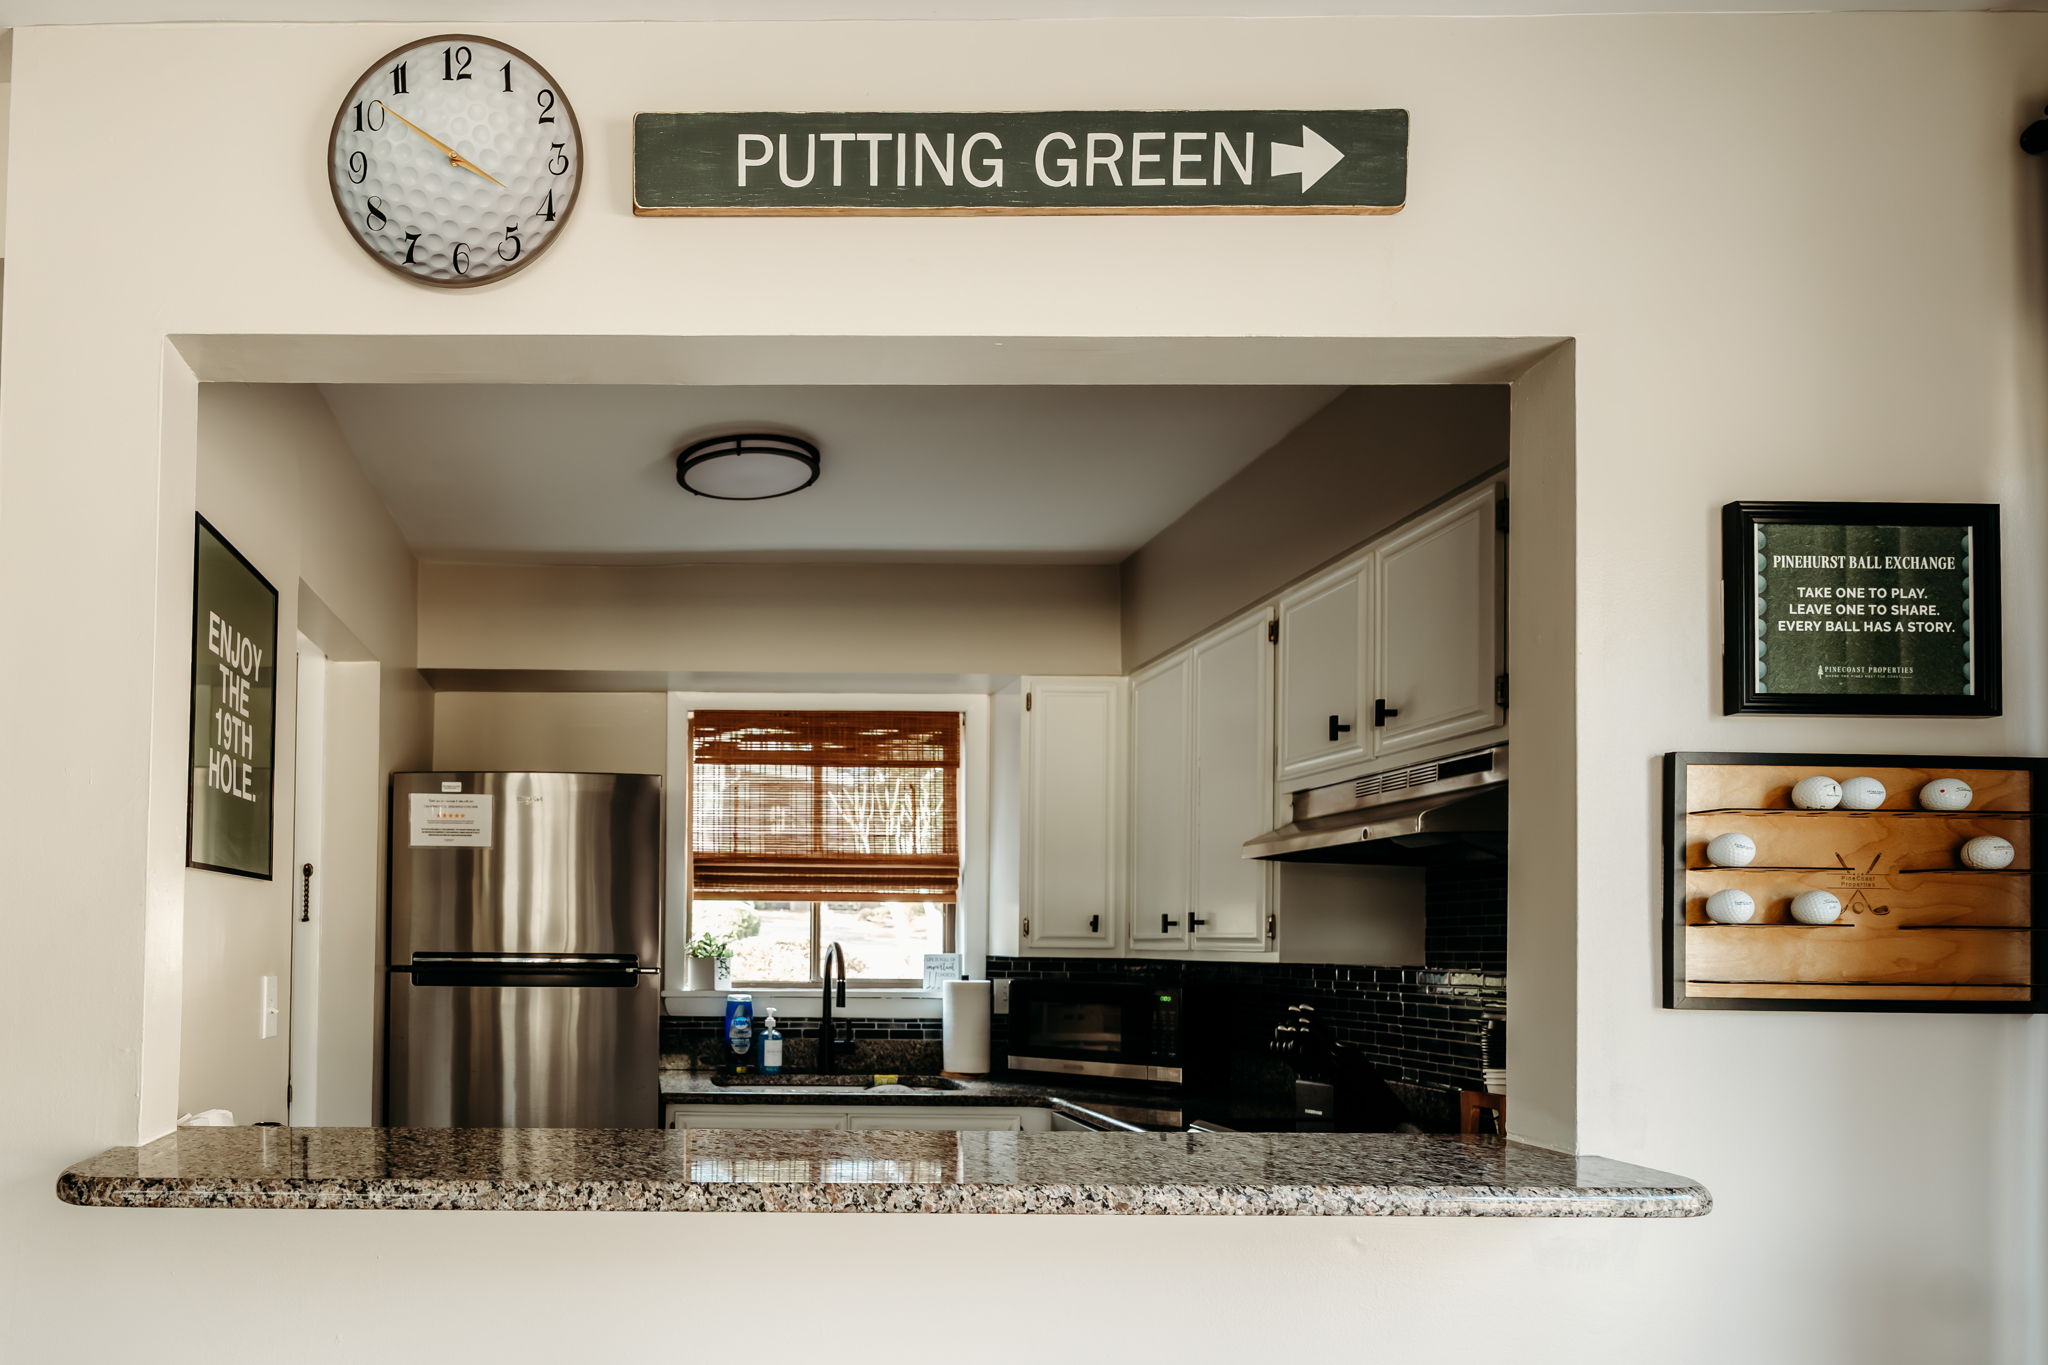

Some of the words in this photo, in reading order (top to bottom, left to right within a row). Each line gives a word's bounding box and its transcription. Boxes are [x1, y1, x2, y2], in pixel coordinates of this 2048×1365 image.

[389, 60, 409, 96] 11
[442, 46, 472, 81] 12
[499, 60, 514, 92] 1
[353, 99, 385, 132] 10
[537, 89, 555, 124] 2
[348, 151, 367, 184] 9
[548, 142, 569, 175] 3
[737, 132, 1004, 188] PUTTING
[1035, 131, 1255, 187] GREEN
[366, 195, 387, 231] 8
[536, 188, 556, 221] 4
[402, 231, 422, 265] 7
[453, 242, 471, 275] 6
[497, 223, 521, 261] 5
[1773, 555, 1846, 569] PINEHURST
[1849, 555, 1882, 569] BALL
[1885, 556, 1956, 570] EXCHANGE
[1789, 603, 1832, 615] LEAVE
[1835, 604, 1865, 615] ONE
[1868, 604, 1887, 615] TO
[1891, 604, 1940, 616] SHARE.
[1797, 587, 1832, 598] TAKE
[1836, 587, 1865, 598] ONE
[1868, 587, 1887, 599] TO
[1891, 588, 1928, 599] PLAY.
[1778, 620, 1822, 632] EVERY
[1825, 621, 1861, 632] BALL
[1863, 621, 1892, 632] HAS
[1894, 621, 1904, 632] A
[1907, 621, 1955, 633] STORY.
[208, 610, 263, 682] ENJOY
[1824, 666, 1865, 674] PINECOAST
[1868, 666, 1914, 674] PROPERTIES
[219, 663, 251, 718] THE
[215, 708, 253, 760] 19TH
[208, 747, 257, 802] HOLE.
